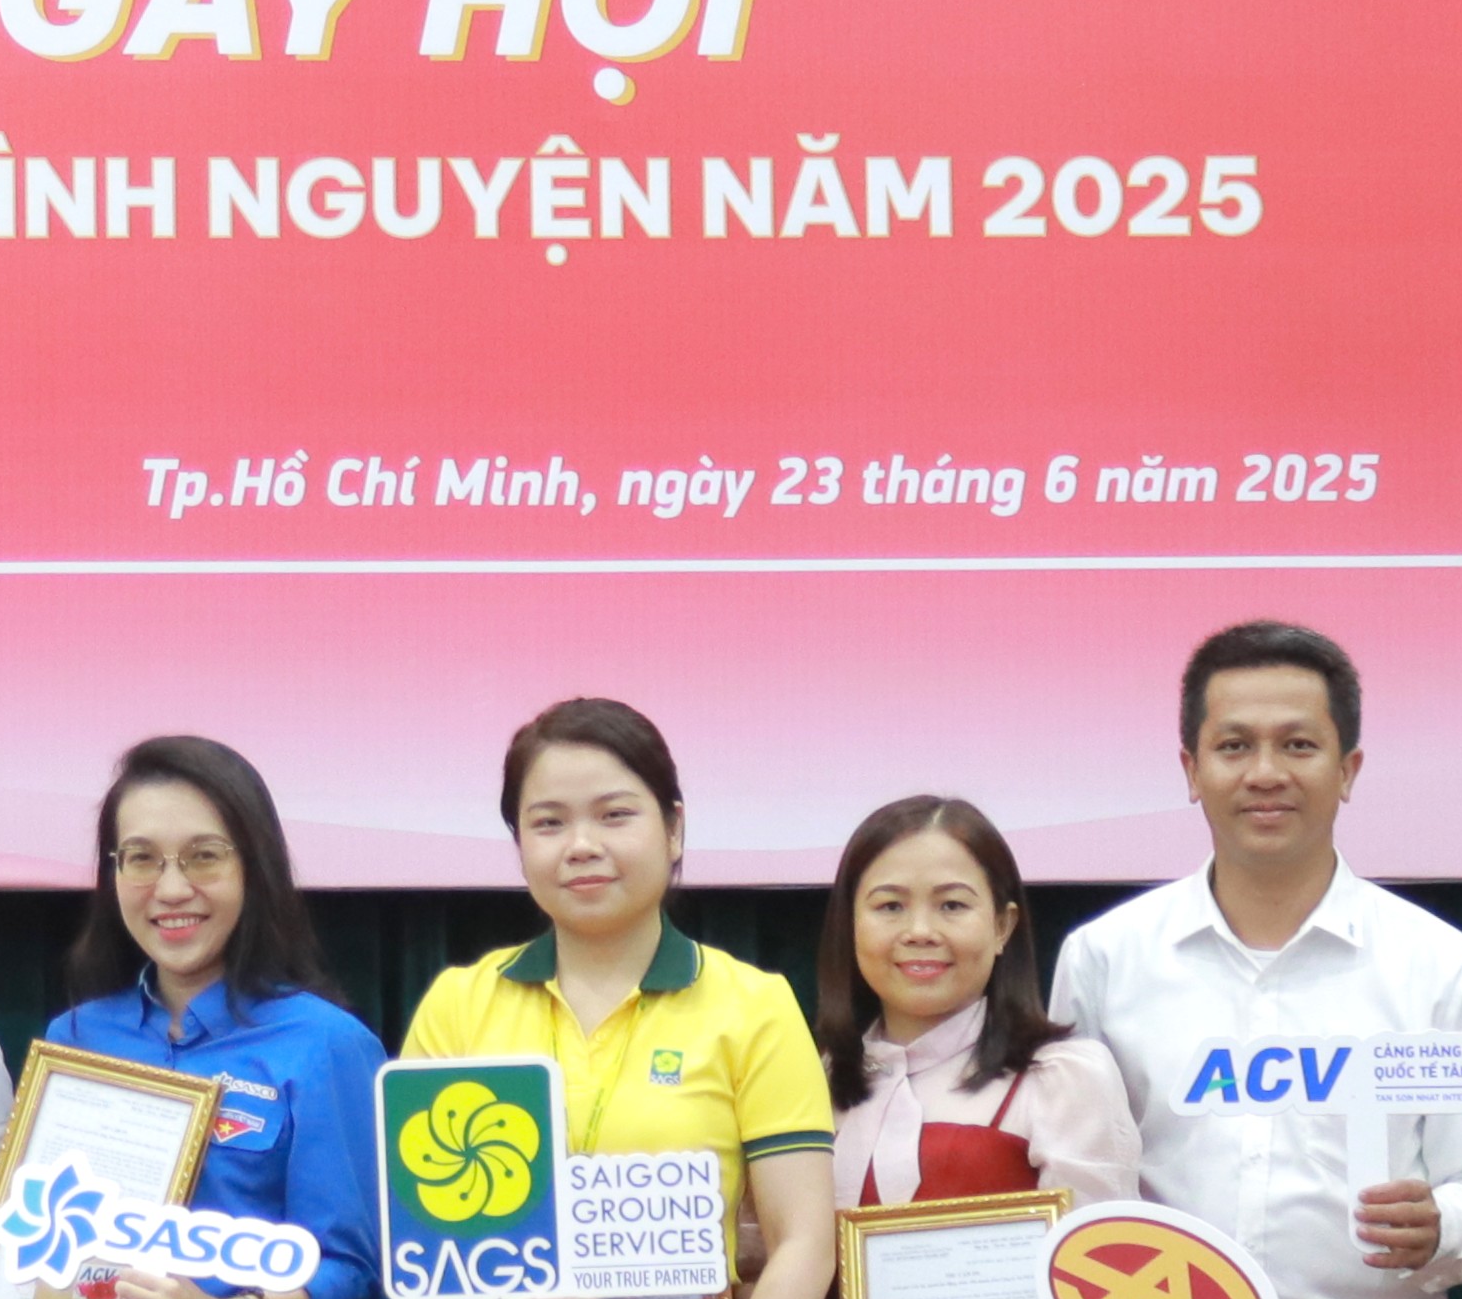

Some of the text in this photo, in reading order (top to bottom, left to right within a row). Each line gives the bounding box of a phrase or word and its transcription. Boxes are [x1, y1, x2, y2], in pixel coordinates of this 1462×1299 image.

[208, 135, 670, 265] NGUYỆN
[703, 134, 952, 238] NĂM
[983, 156, 1262, 236] 2025
[144, 450, 1378, 518] Tp.Hồ Chí Minh, ngày 23 tháng 6 năm 2025
[1374, 1042, 1415, 1059] CẢNG
[1419, 1041, 1462, 1058] HÀNG
[1184, 1047, 1352, 1104] ACV
[1374, 1061, 1416, 1081] QUỐC
[1420, 1060, 1439, 1078] TẾ
[571, 1160, 711, 1191] SAIGON
[572, 1195, 714, 1224] GROUND
[104, 1211, 305, 1279] SASCO
[574, 1228, 714, 1258] SERVICES
[396, 1238, 558, 1298] SAGS
[573, 1268, 717, 1290] YOUR TRUE PARTNER
